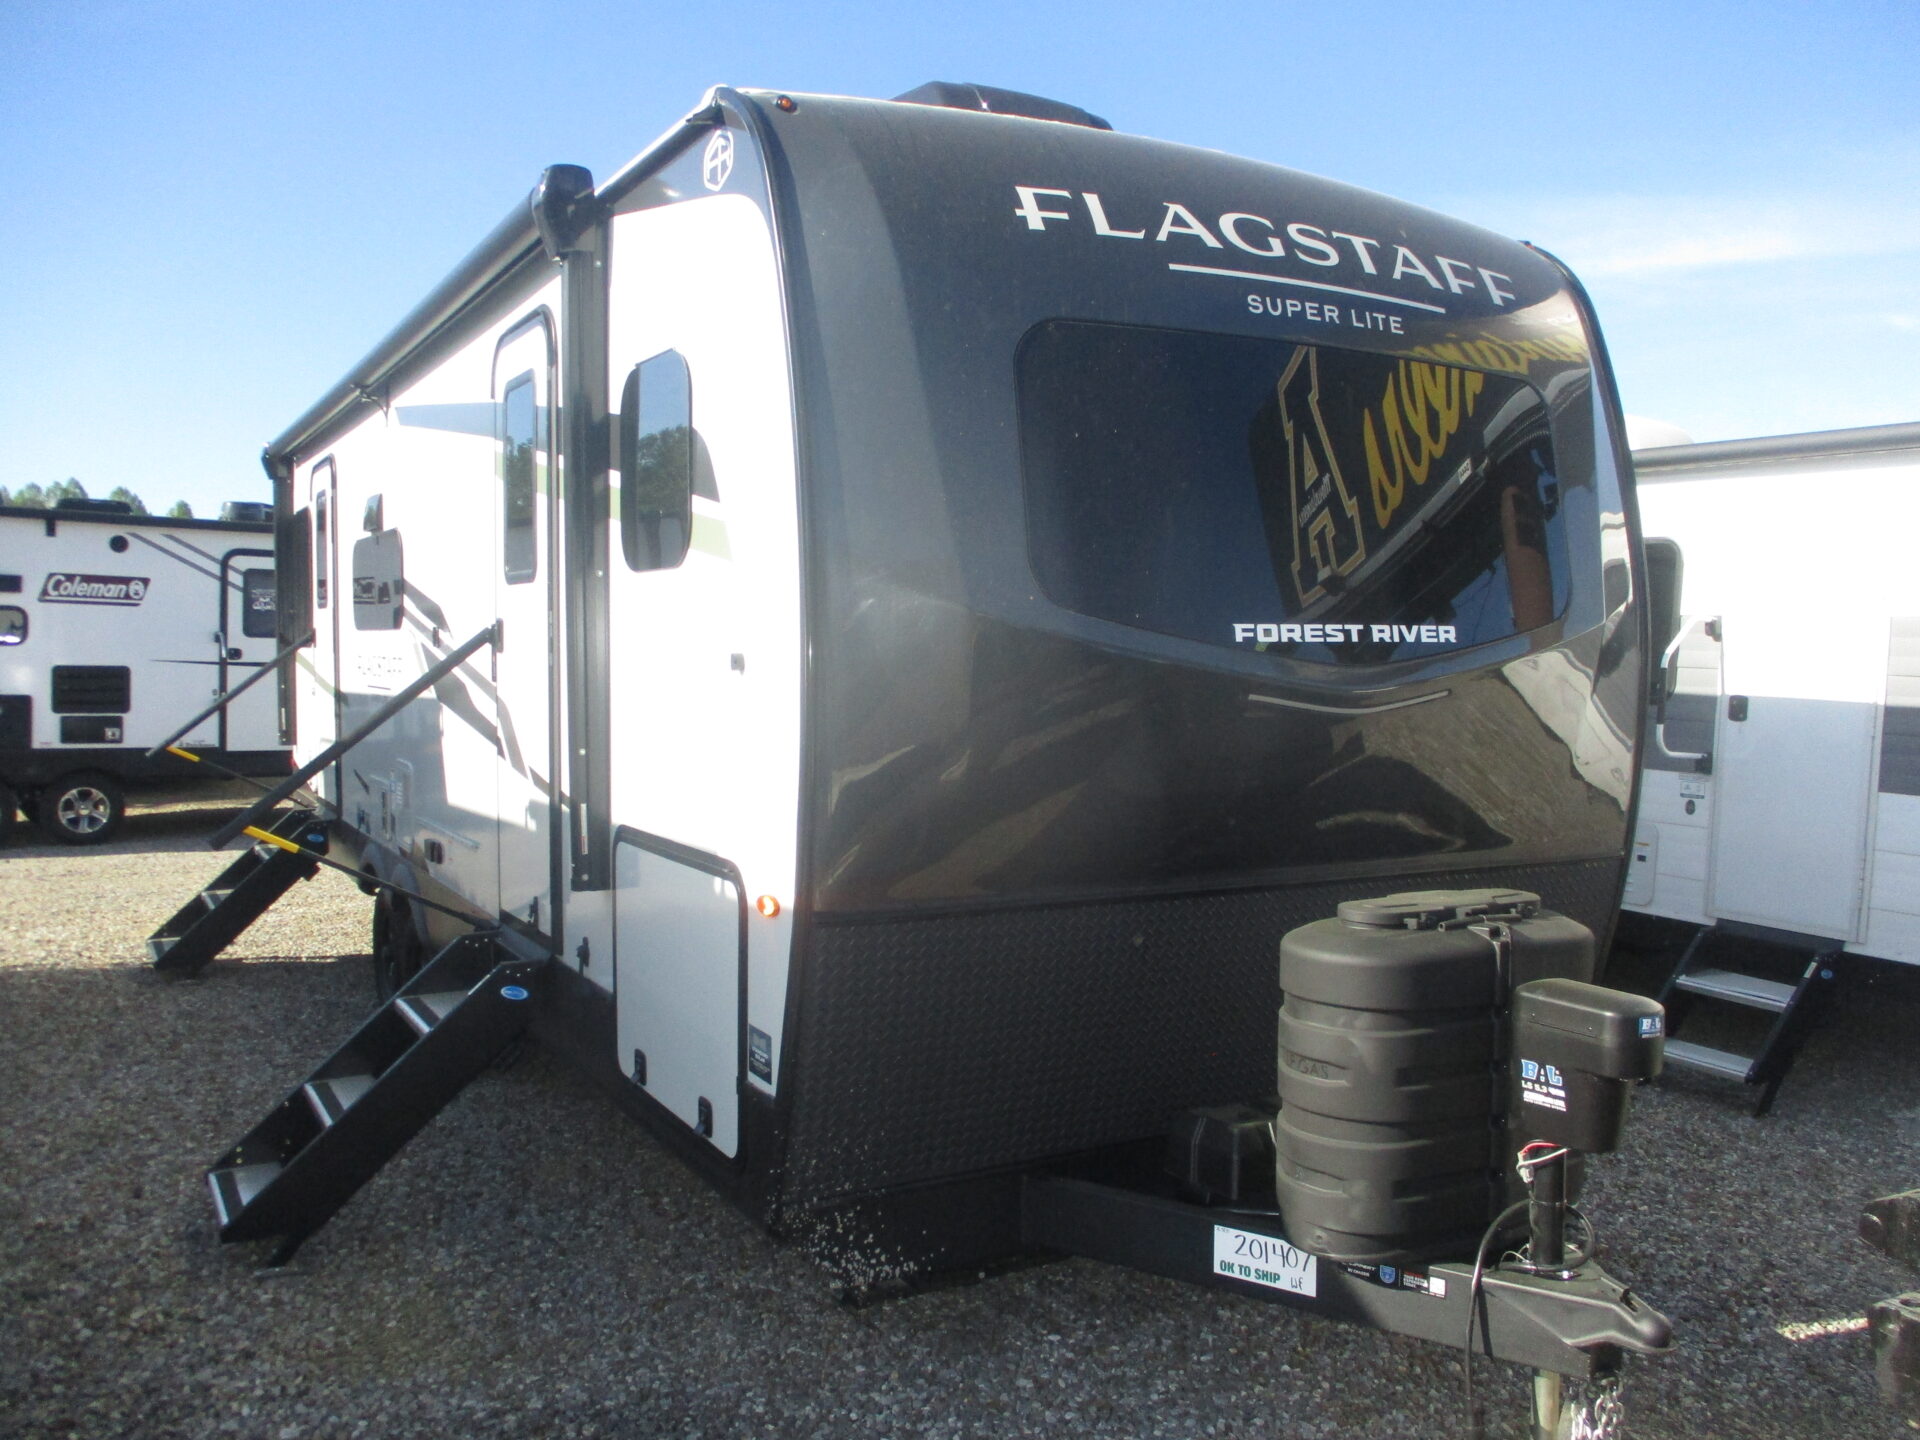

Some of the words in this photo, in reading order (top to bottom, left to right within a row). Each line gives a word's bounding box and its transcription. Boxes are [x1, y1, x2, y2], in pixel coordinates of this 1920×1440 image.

[1014, 185, 1516, 307] FLAGSTAFF
[1247, 294, 1341, 325] SUPER
[1350, 308, 1404, 335] LITE
[47, 574, 127, 598] Coleman
[1233, 623, 1363, 643] FOREST
[1370, 624, 1457, 643] RIVER
[1220, 1260, 1235, 1273] OK
[1238, 1264, 1251, 1277] TO
[1254, 1269, 1280, 1283] SHIP
